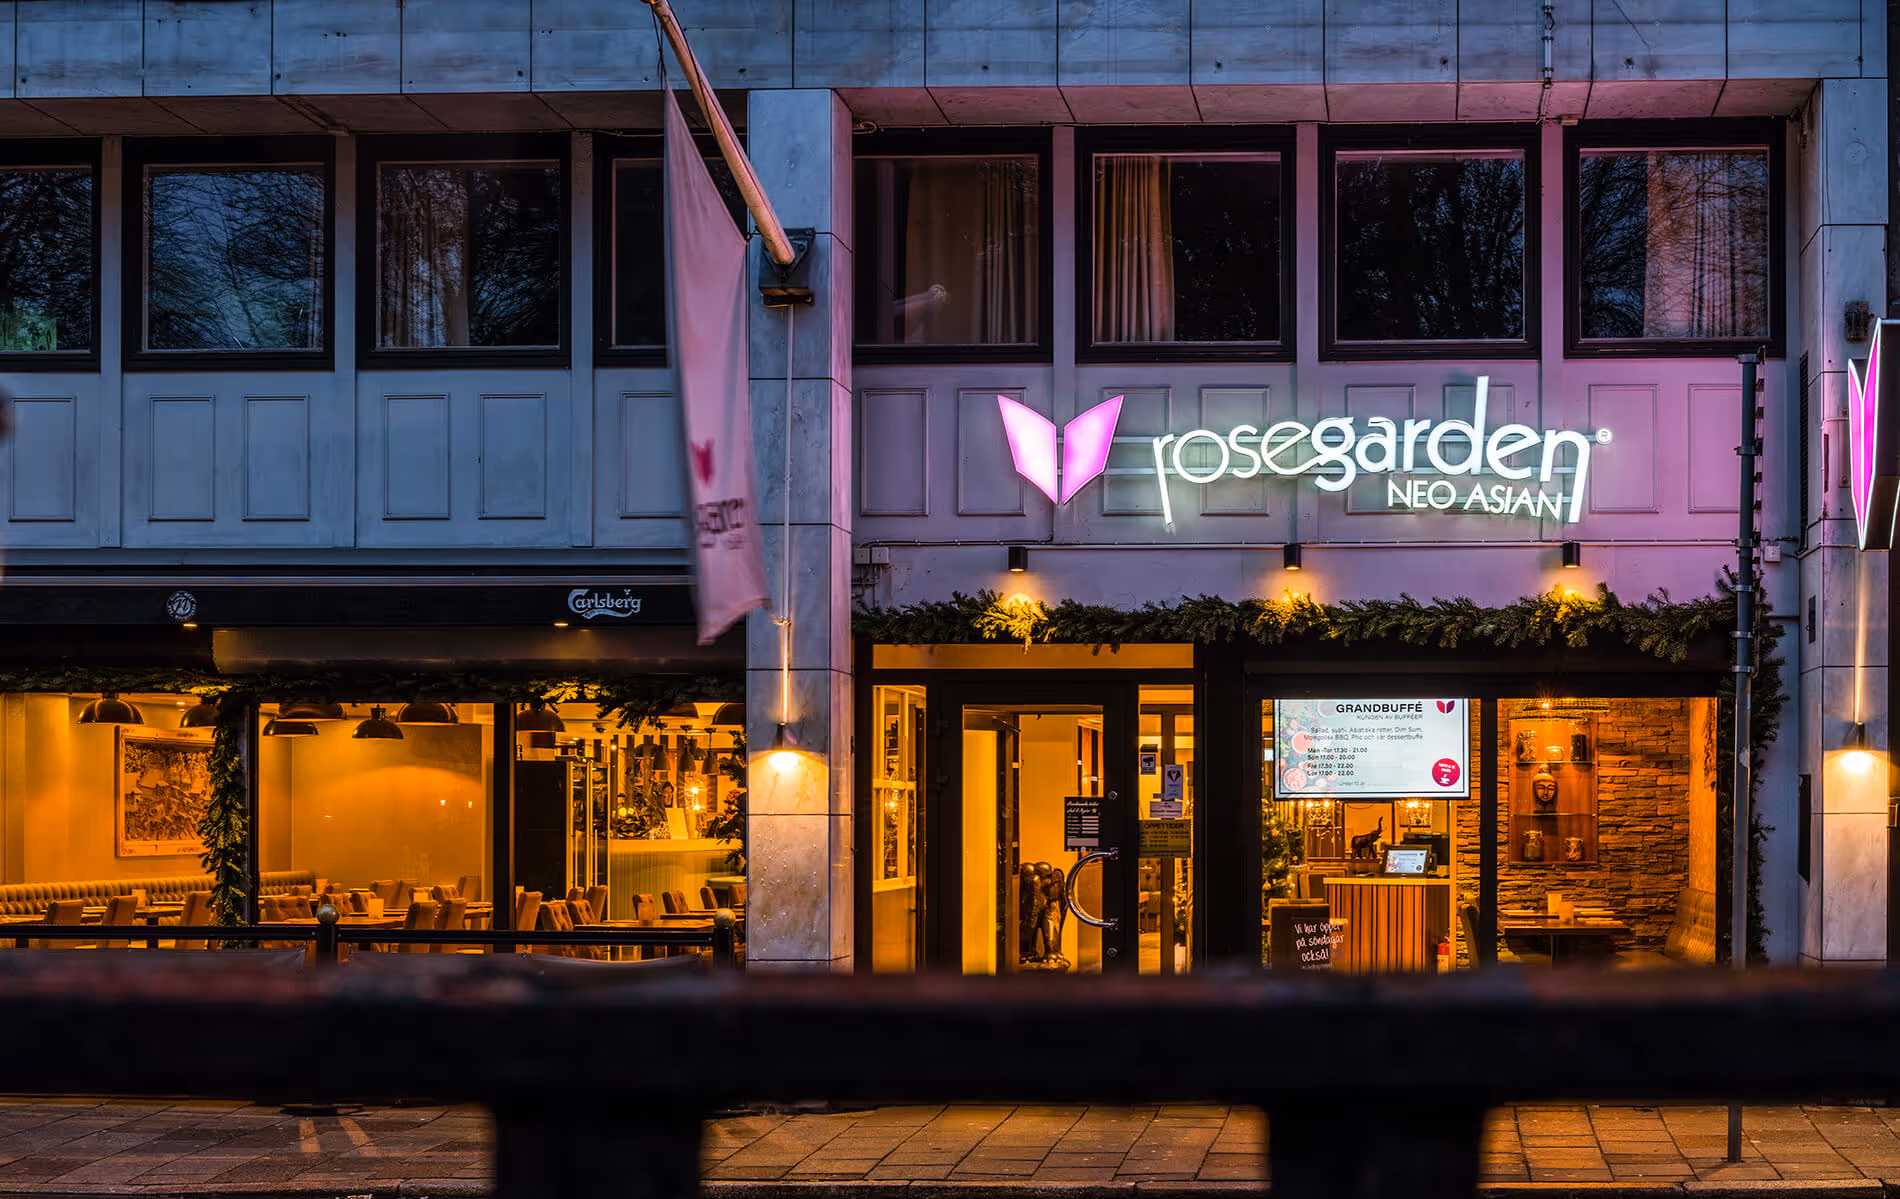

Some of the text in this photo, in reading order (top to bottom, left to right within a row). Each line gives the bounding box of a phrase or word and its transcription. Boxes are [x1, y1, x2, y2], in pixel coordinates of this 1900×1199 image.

[1152, 375, 1591, 525] rosegarden
[1387, 479, 1564, 520] NEO ASIAN
[567, 588, 643, 615] Carlsberg
[1336, 701, 1423, 713] GRANDBUFFÉ
[1294, 923, 1303, 934] Vi
[1304, 923, 1317, 934] har
[1296, 937, 1307, 950] på
